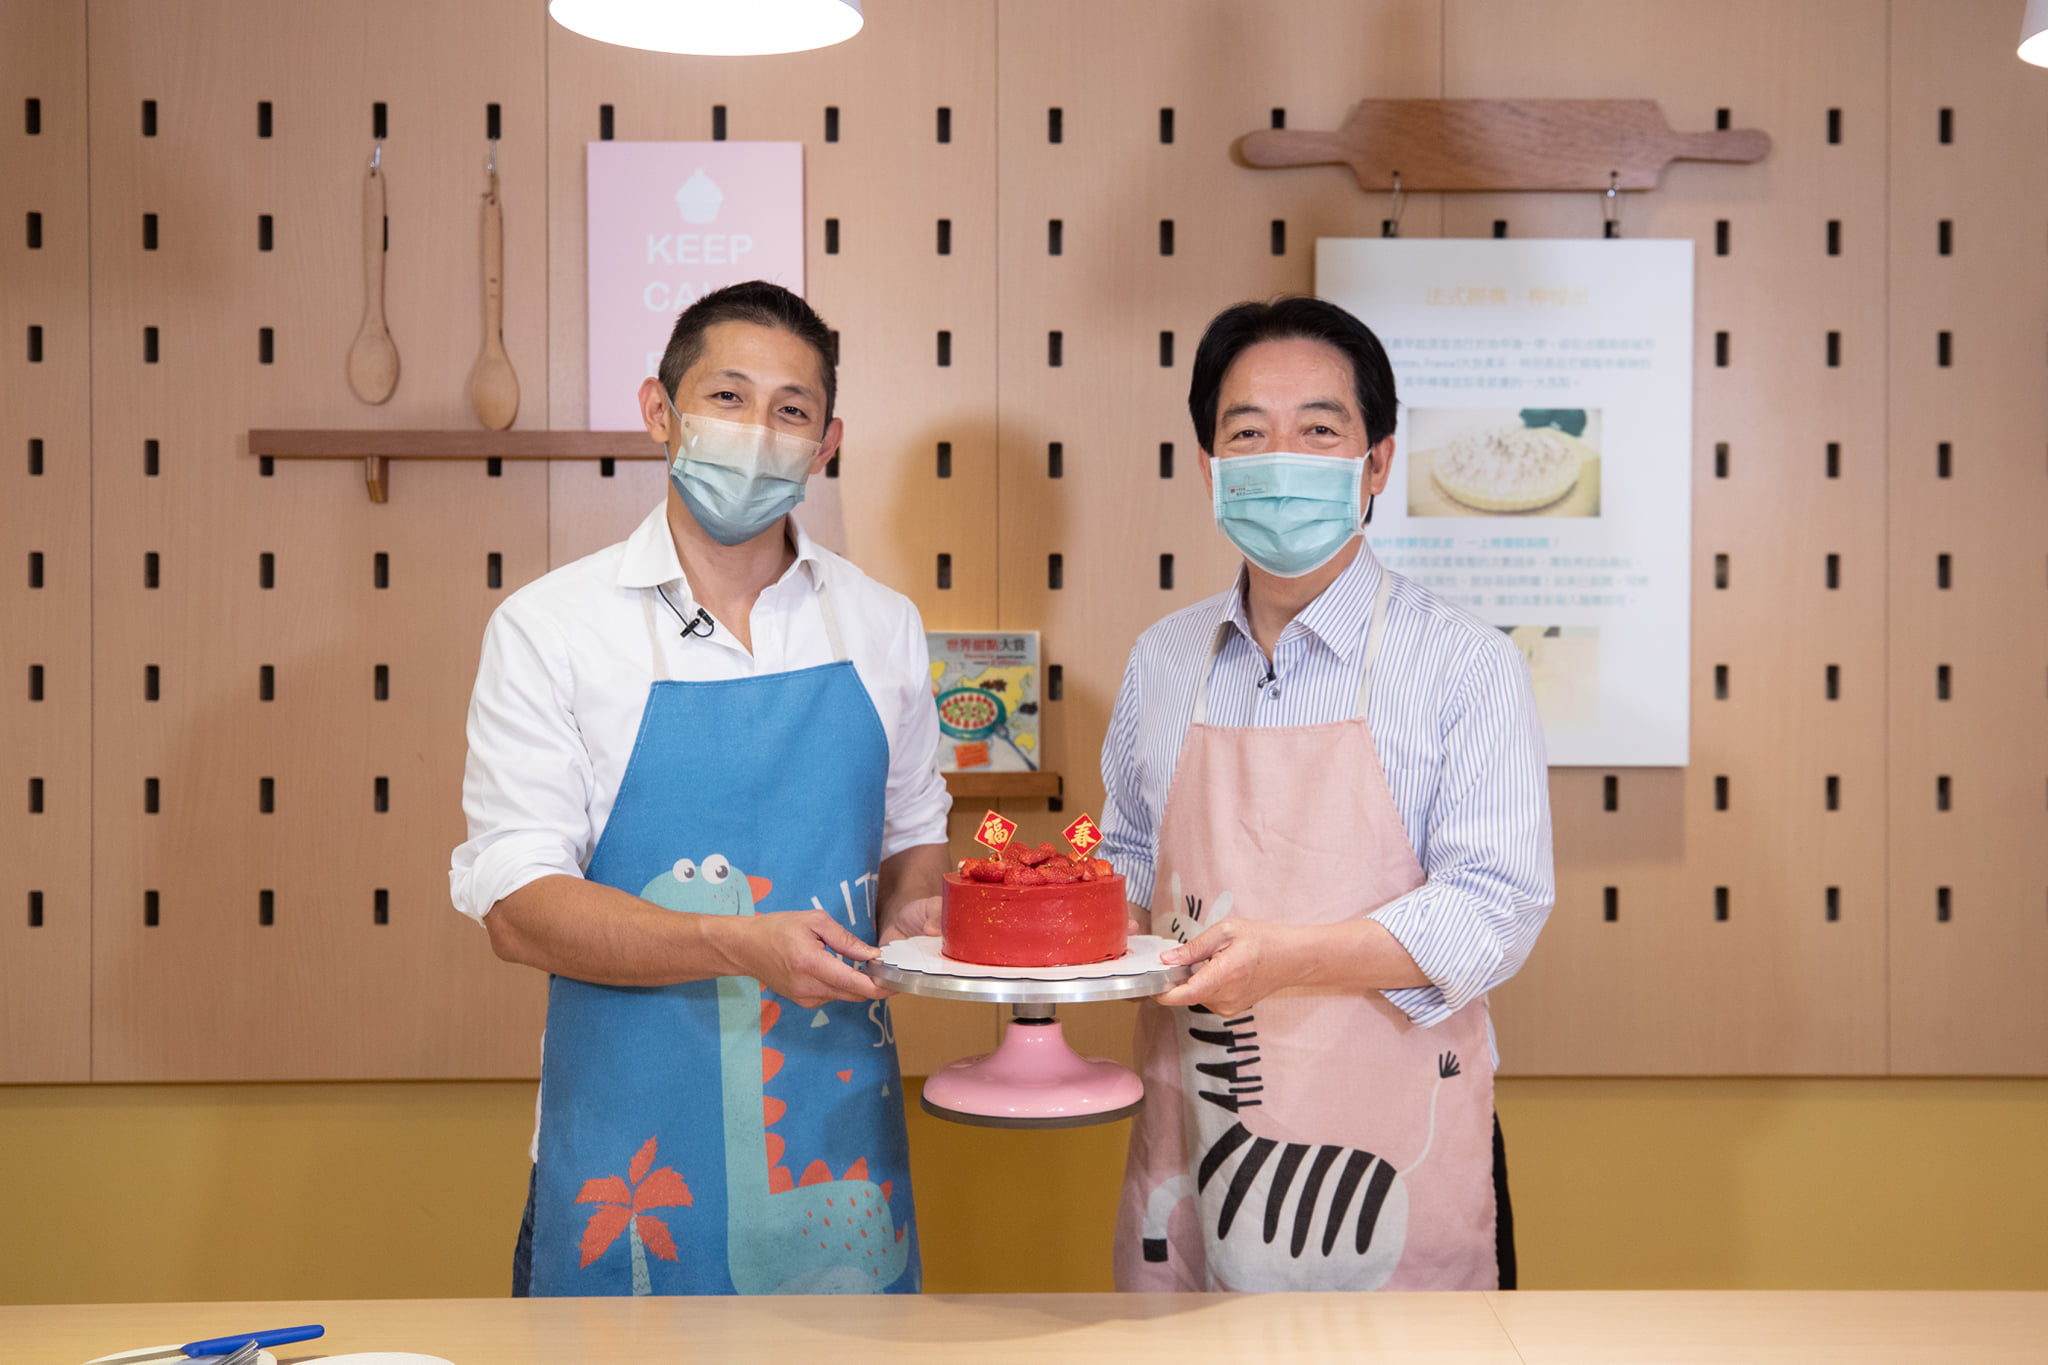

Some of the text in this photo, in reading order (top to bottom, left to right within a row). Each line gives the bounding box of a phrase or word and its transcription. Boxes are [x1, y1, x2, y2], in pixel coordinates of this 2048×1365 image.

[646, 233, 753, 265] KEEP
[984, 817, 1009, 846] 福
[1070, 820, 1097, 848] 春
